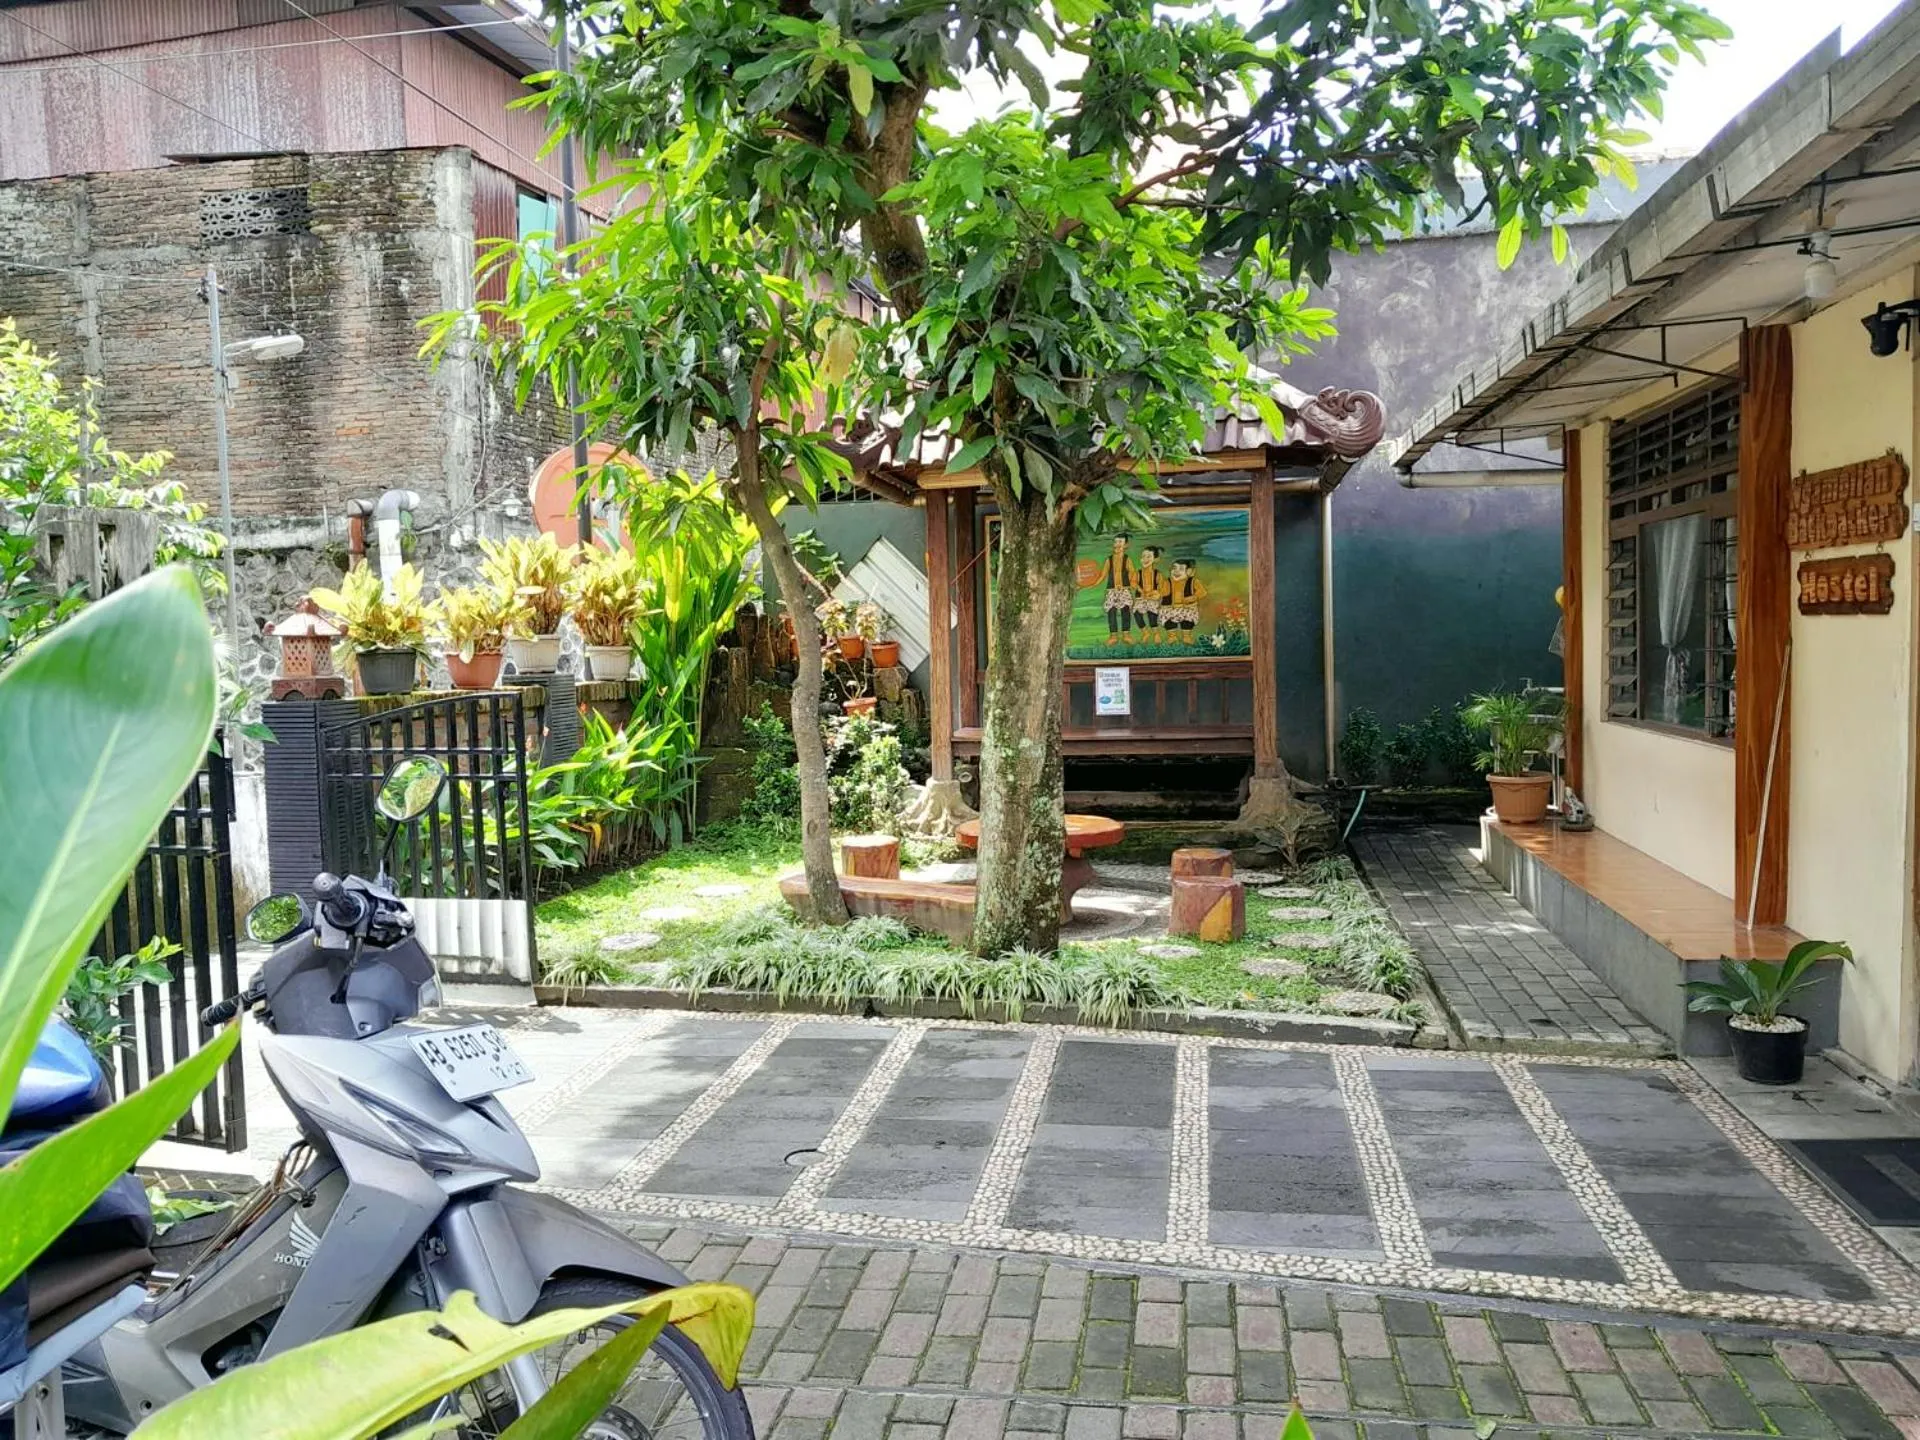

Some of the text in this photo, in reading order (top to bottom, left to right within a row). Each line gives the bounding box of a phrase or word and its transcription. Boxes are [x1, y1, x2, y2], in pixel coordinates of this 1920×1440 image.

[1801, 566, 1879, 604] Hostel
[419, 1039, 447, 1067] AB
[443, 1033, 487, 1060] 6250
